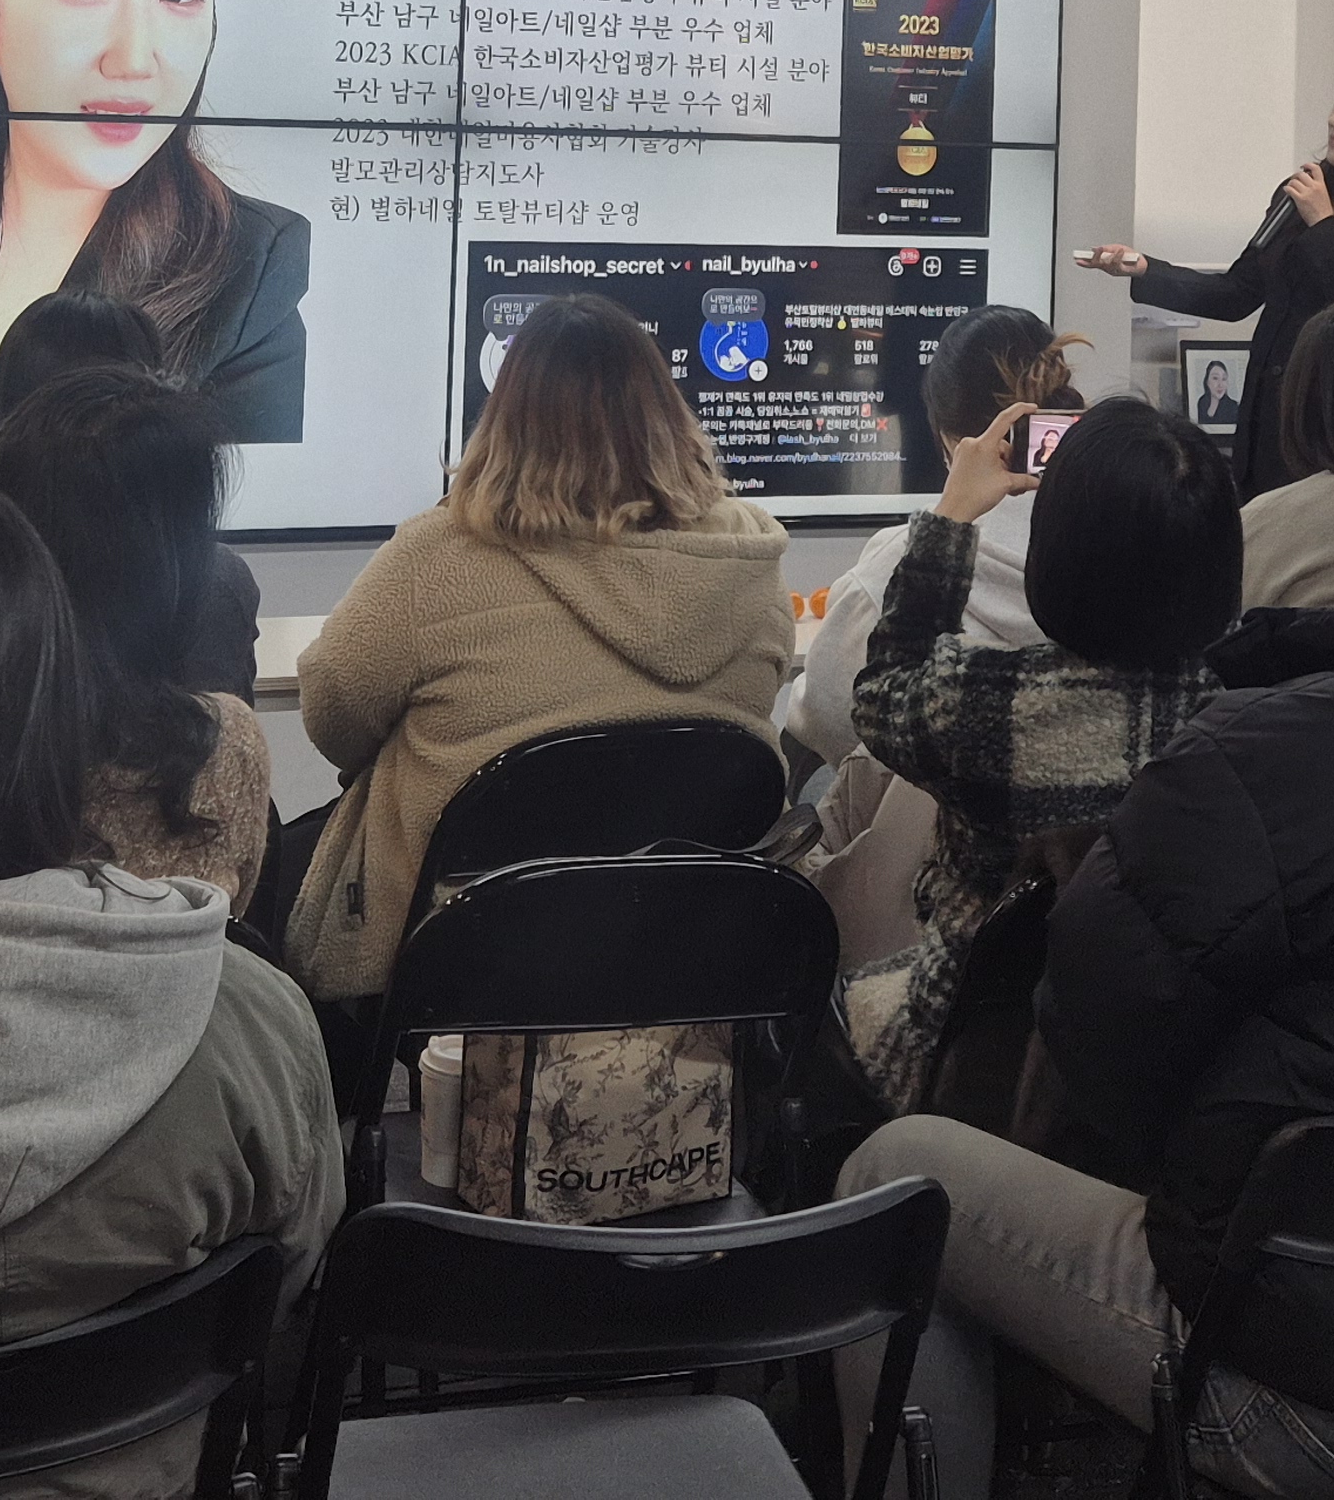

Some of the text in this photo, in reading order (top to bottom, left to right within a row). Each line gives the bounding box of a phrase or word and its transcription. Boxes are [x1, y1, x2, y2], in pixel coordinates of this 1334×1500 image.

[336, 0, 774, 46] 부산 남구 네일아트/네일샵 부분 우수 업체
[898, 14, 941, 35] 2023
[335, 40, 830, 84] 2023 KCIA 한국소비자산업평가 뷰티 시설 분야
[862, 42, 975, 61] 한국소비자산업평가
[333, 76, 772, 118] 부산 남구 네일아트/네일샵 부분 우수 업체
[329, 195, 640, 227] 현) 별하네일 토탈뷰티샵 운영
[484, 254, 665, 277] 1n_nailshop_secret
[702, 254, 796, 275] nail_byulha
[536, 1141, 722, 1194] SOUTHCAPE
